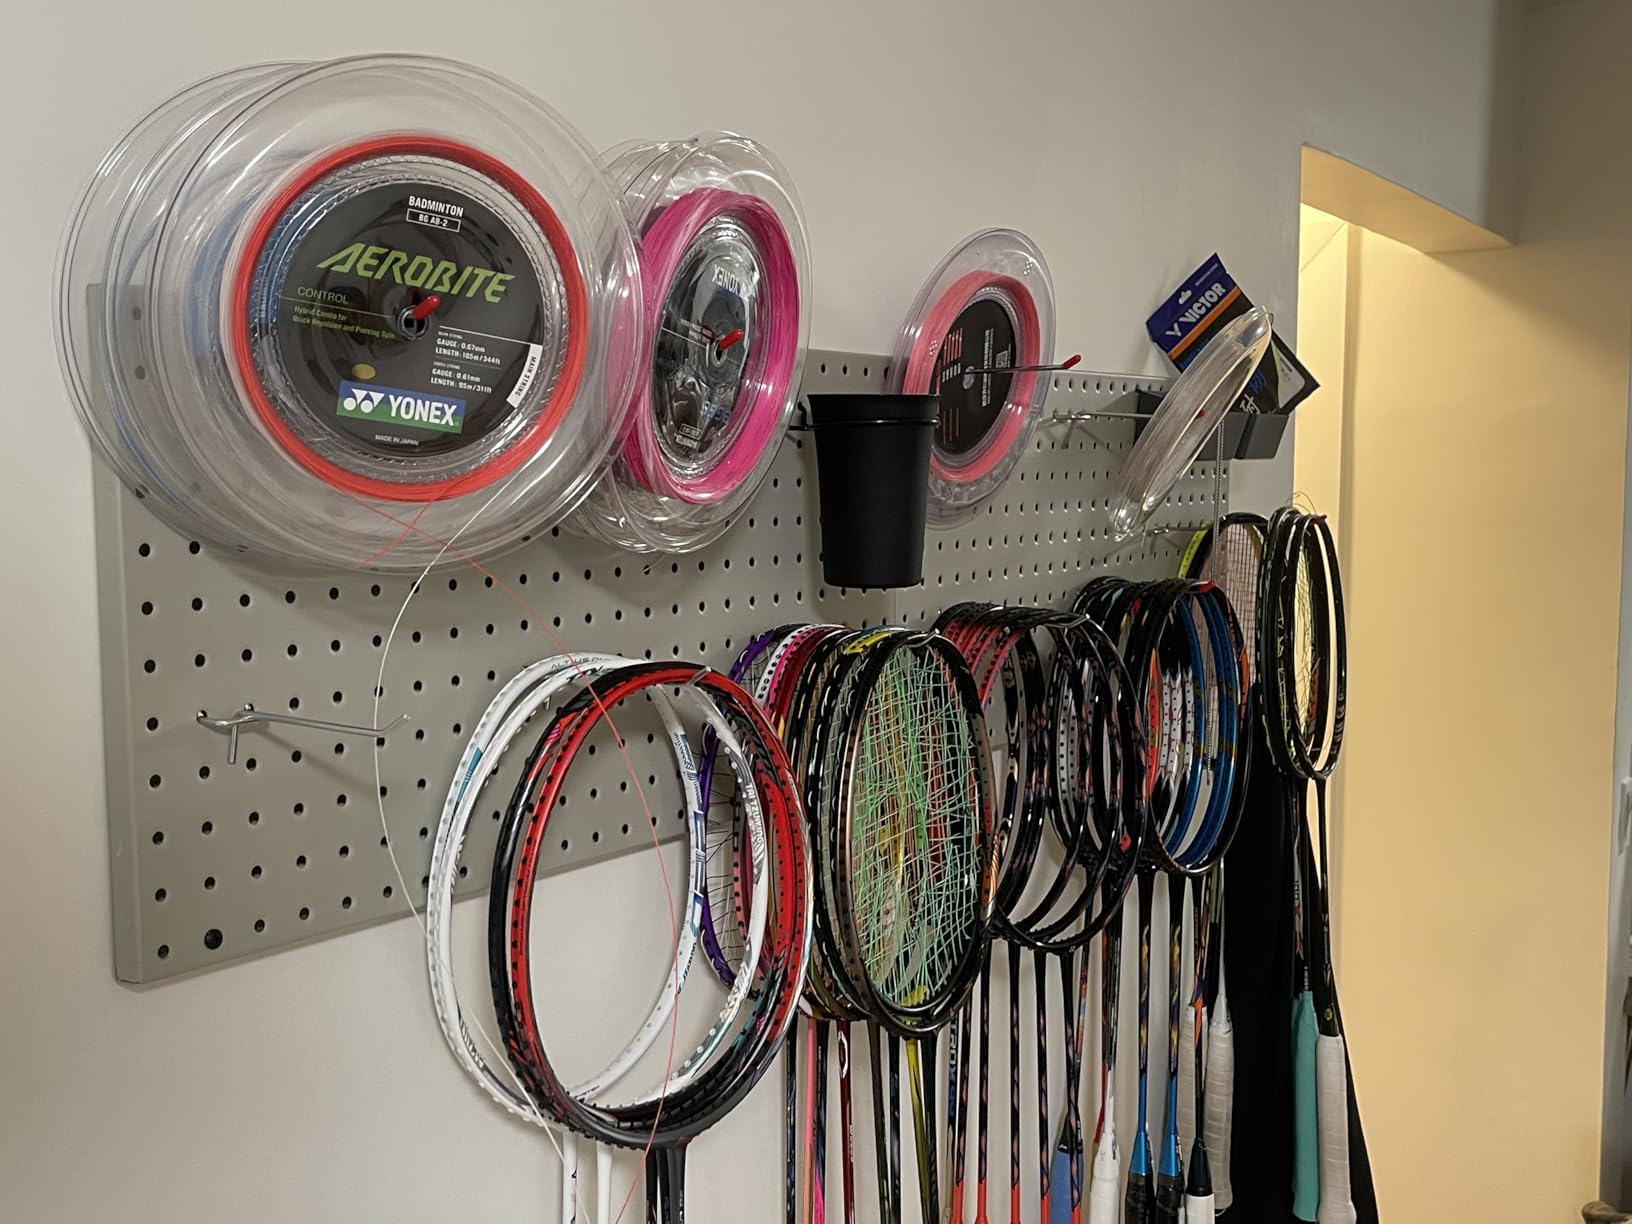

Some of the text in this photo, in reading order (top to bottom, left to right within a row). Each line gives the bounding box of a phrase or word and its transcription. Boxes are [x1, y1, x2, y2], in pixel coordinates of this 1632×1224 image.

[408, 195, 464, 217] BADMINTON
[418, 213, 429, 223] BG
[316, 242, 516, 303] AEROBITE
[712, 264, 739, 296] YONEX
[297, 286, 349, 304] CONTROL
[1178, 282, 1226, 323] VICTOR
[515, 356, 538, 396] MAIN STRING
[388, 394, 457, 426] YONEX
